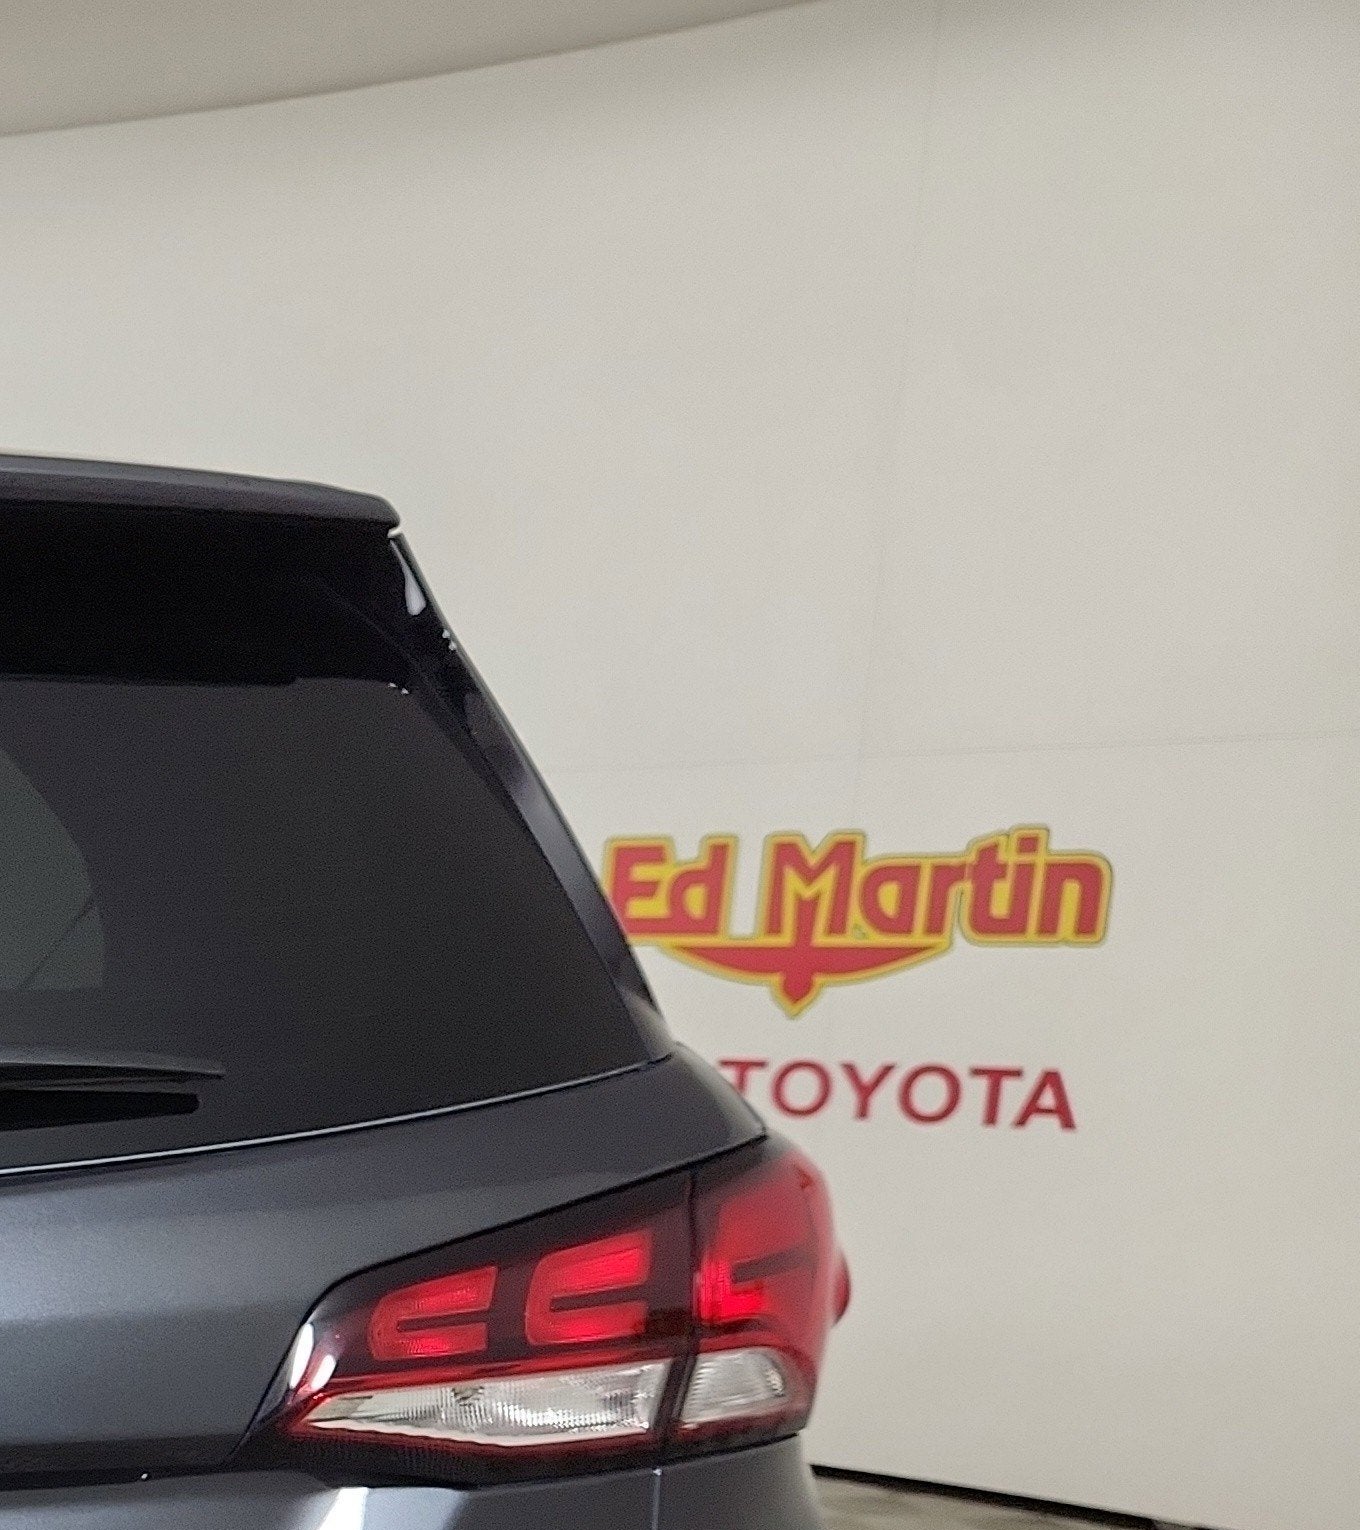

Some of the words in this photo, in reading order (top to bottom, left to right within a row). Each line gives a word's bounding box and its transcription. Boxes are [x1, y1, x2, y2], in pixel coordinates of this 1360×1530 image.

[606, 836, 737, 937] Ed
[764, 825, 1111, 946] Martin
[719, 1058, 1077, 1130] TOYOTA
